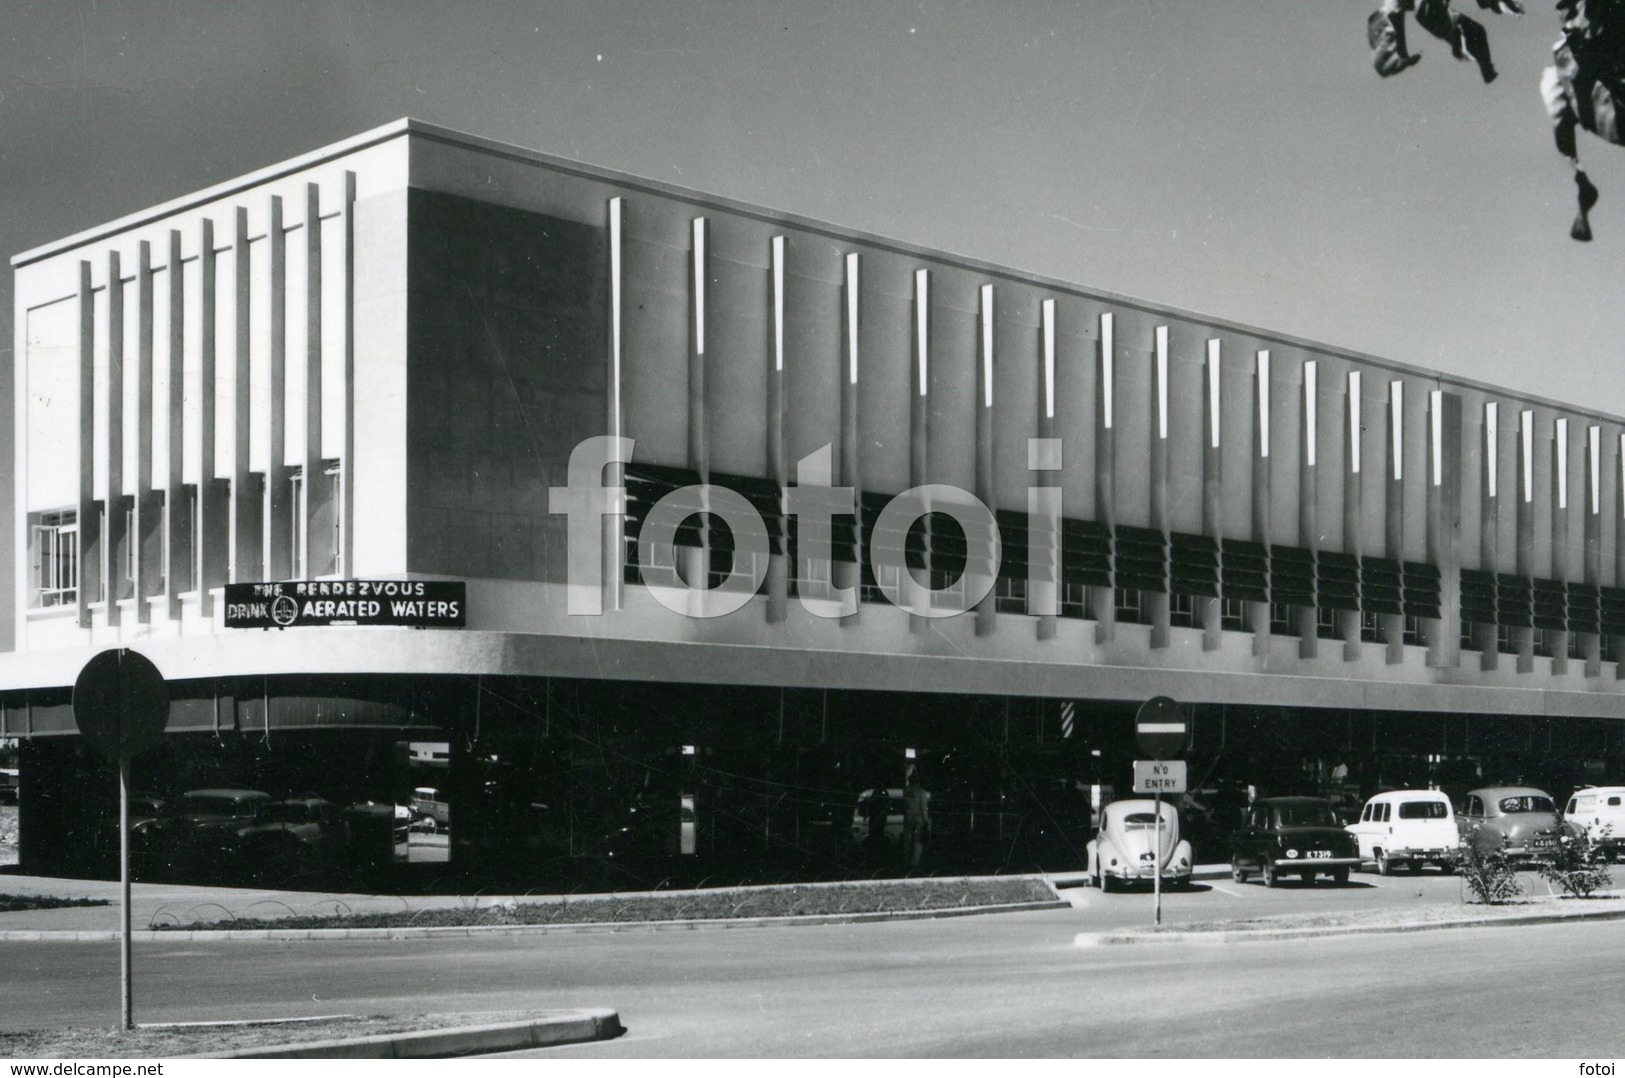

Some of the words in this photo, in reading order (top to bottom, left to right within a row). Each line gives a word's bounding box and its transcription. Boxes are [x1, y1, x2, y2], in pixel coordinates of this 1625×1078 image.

[253, 583, 283, 597] THE
[296, 582, 425, 596] RENDEZVOUS
[227, 603, 269, 619] DRINK
[302, 600, 380, 617] AERATED
[390, 601, 459, 617] WATERS
[1153, 765, 1169, 775] NO
[1145, 779, 1176, 788] ENTRY
